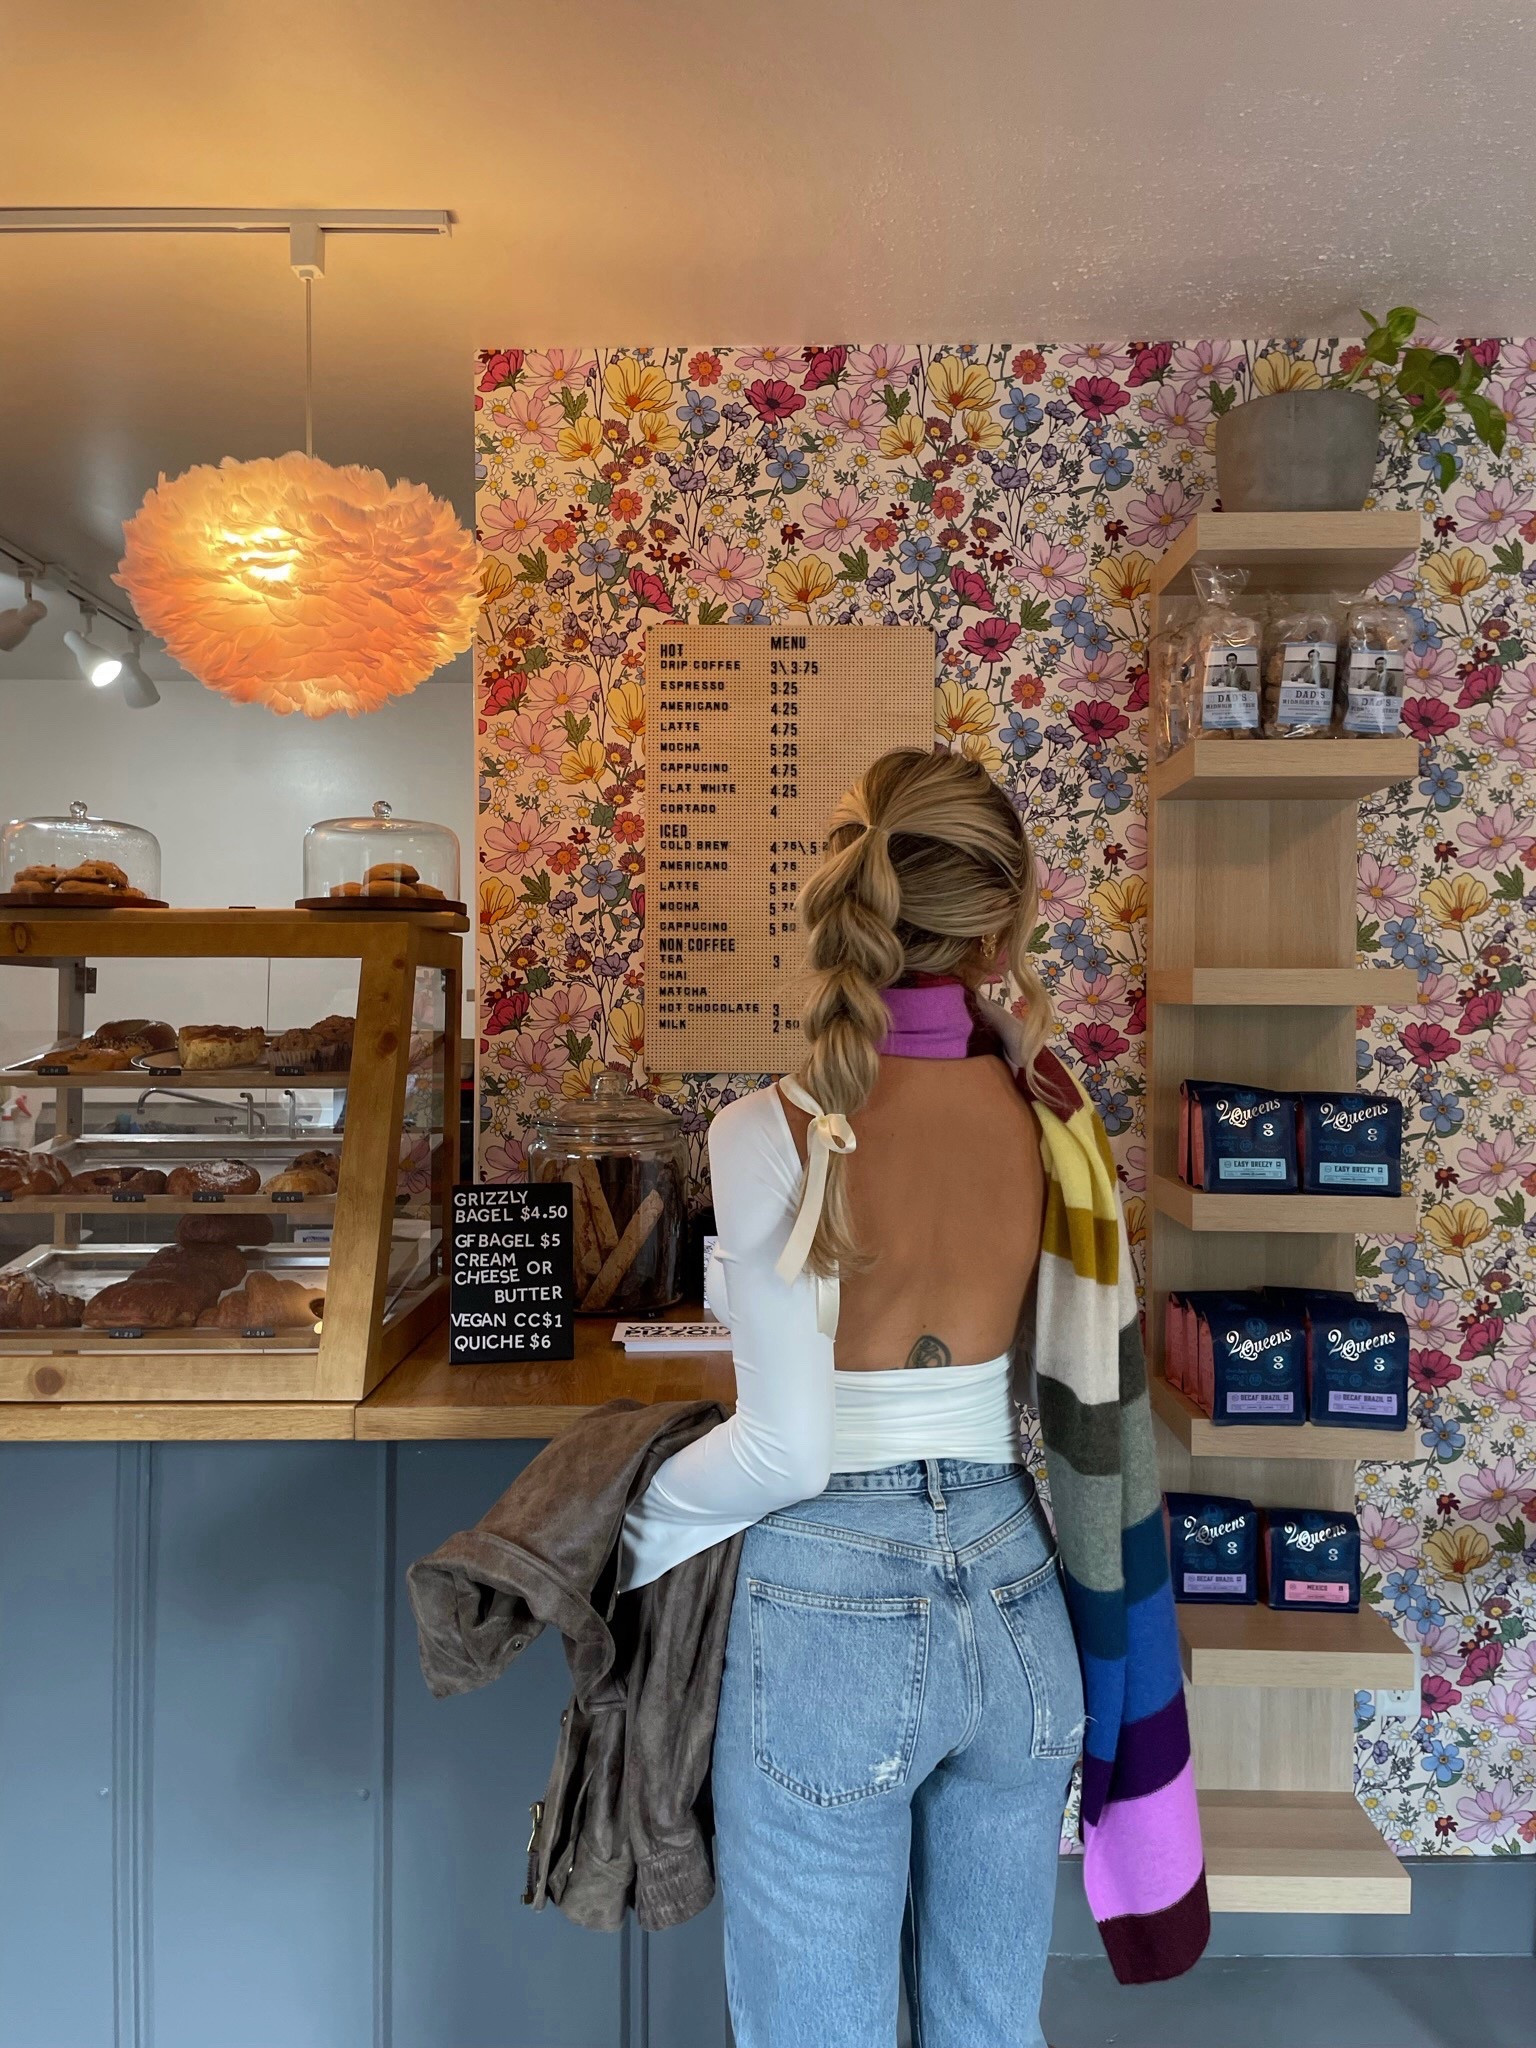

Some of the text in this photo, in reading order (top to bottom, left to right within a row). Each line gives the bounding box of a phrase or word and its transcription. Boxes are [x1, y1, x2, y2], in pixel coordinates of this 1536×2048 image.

[771, 636, 806, 650] MENU
[661, 644, 684, 657] HOT
[661, 660, 688, 670] DRIP
[693, 661, 741, 671] COFFEE
[661, 681, 725, 691] ESPRESSO
[661, 702, 729, 712] AMERICANO
[661, 722, 700, 732] LATTE
[660, 743, 700, 752] MOCHA
[660, 763, 729, 773] CAPPUCINO
[660, 783, 692, 793] FLAT
[700, 784, 737, 794] WHITE
[660, 804, 777, 819] CORTADO 4
[660, 824, 688, 838] ICED
[660, 841, 691, 850] COLD
[697, 841, 729, 851] BREW
[660, 861, 728, 871] AMERICANO
[660, 881, 699, 891] LATTE
[660, 902, 700, 912] MOCHA
[660, 922, 728, 932] CAPPUCINO
[660, 938, 735, 953] NON COFFEE
[660, 955, 780, 969] TEA 3
[660, 971, 687, 981] CHAI
[659, 987, 707, 997] MATCHA
[660, 1003, 780, 1017] HOT CHOCOLATE 3
[659, 1019, 686, 1030] MILK
[454, 1190, 529, 1207] GRIZZLY
[455, 1205, 568, 1223] BAGEL $4.50
[540, 1232, 561, 1249] $5
[455, 1252, 516, 1267] CREAM
[455, 1261, 553, 1285] CHEESE OR
[494, 1285, 563, 1304] BUTTER
[451, 1312, 507, 1327] VEGAN
[454, 1333, 551, 1352] QUICHE $6
